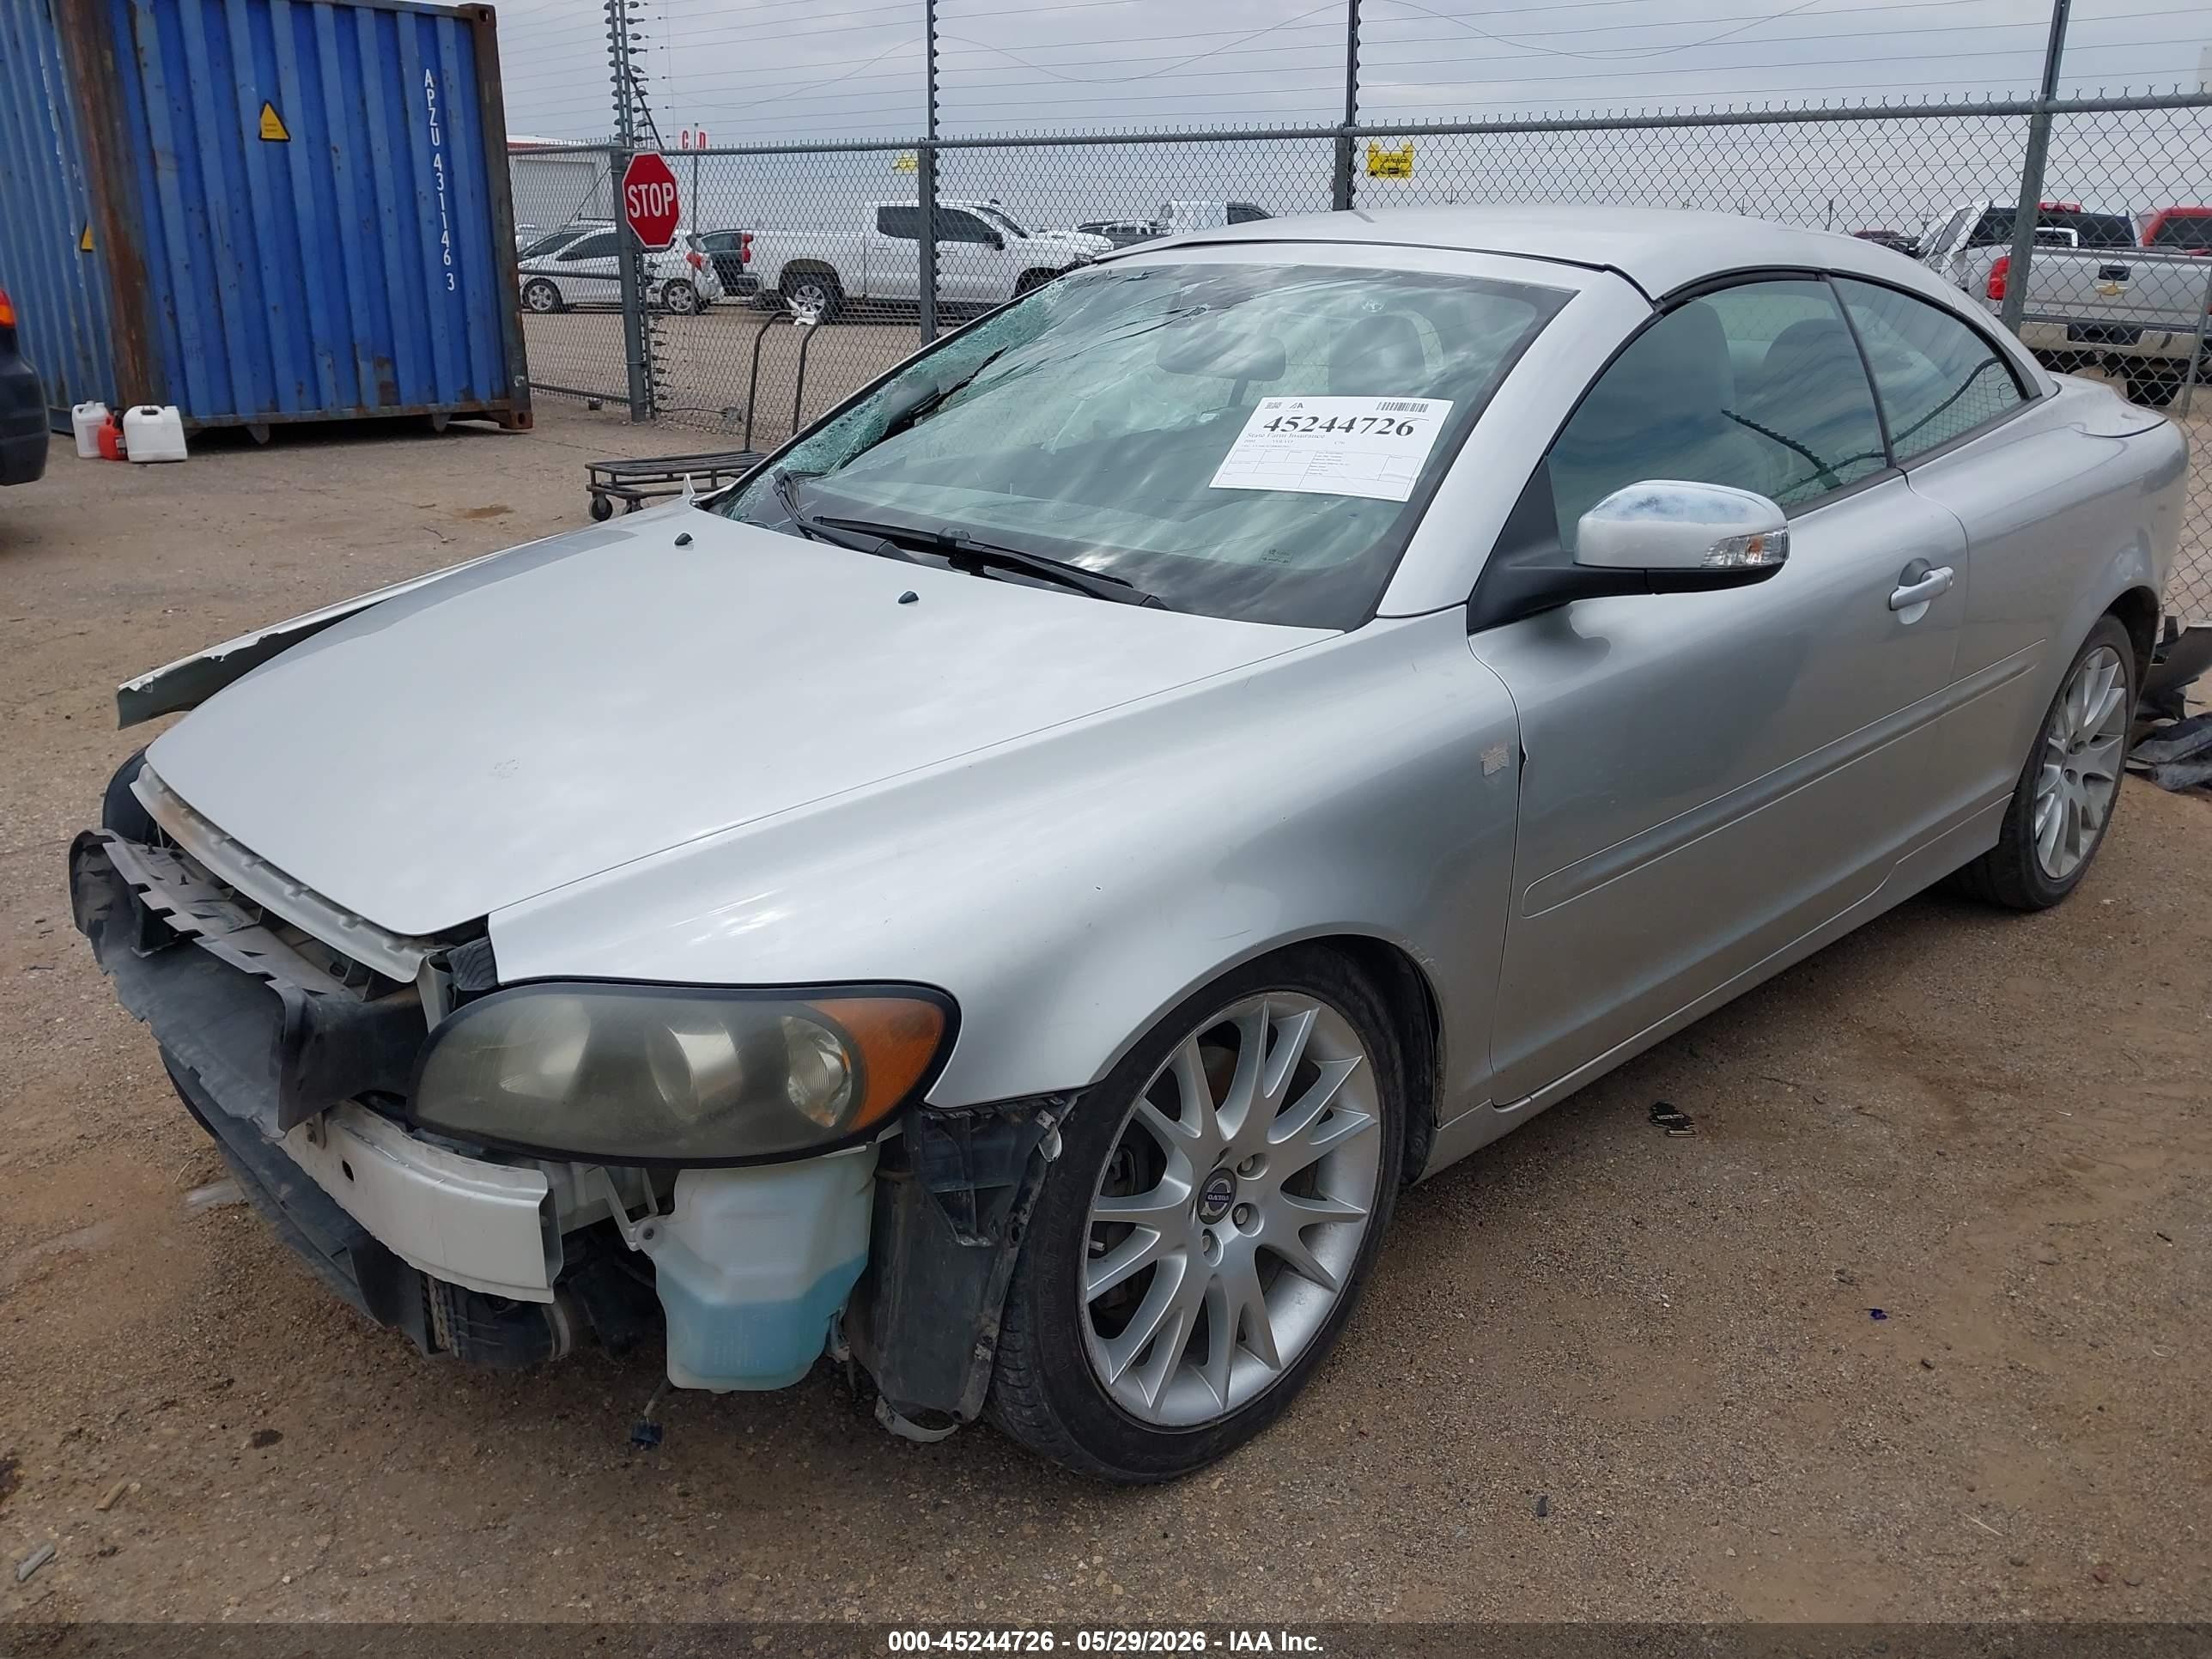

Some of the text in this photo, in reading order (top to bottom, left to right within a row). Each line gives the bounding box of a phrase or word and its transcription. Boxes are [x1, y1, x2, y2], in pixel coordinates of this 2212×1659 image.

[424, 68, 455, 291] APZU 431146 3
[628, 182, 674, 218] STOP
[1263, 416, 1421, 436] 45244726
